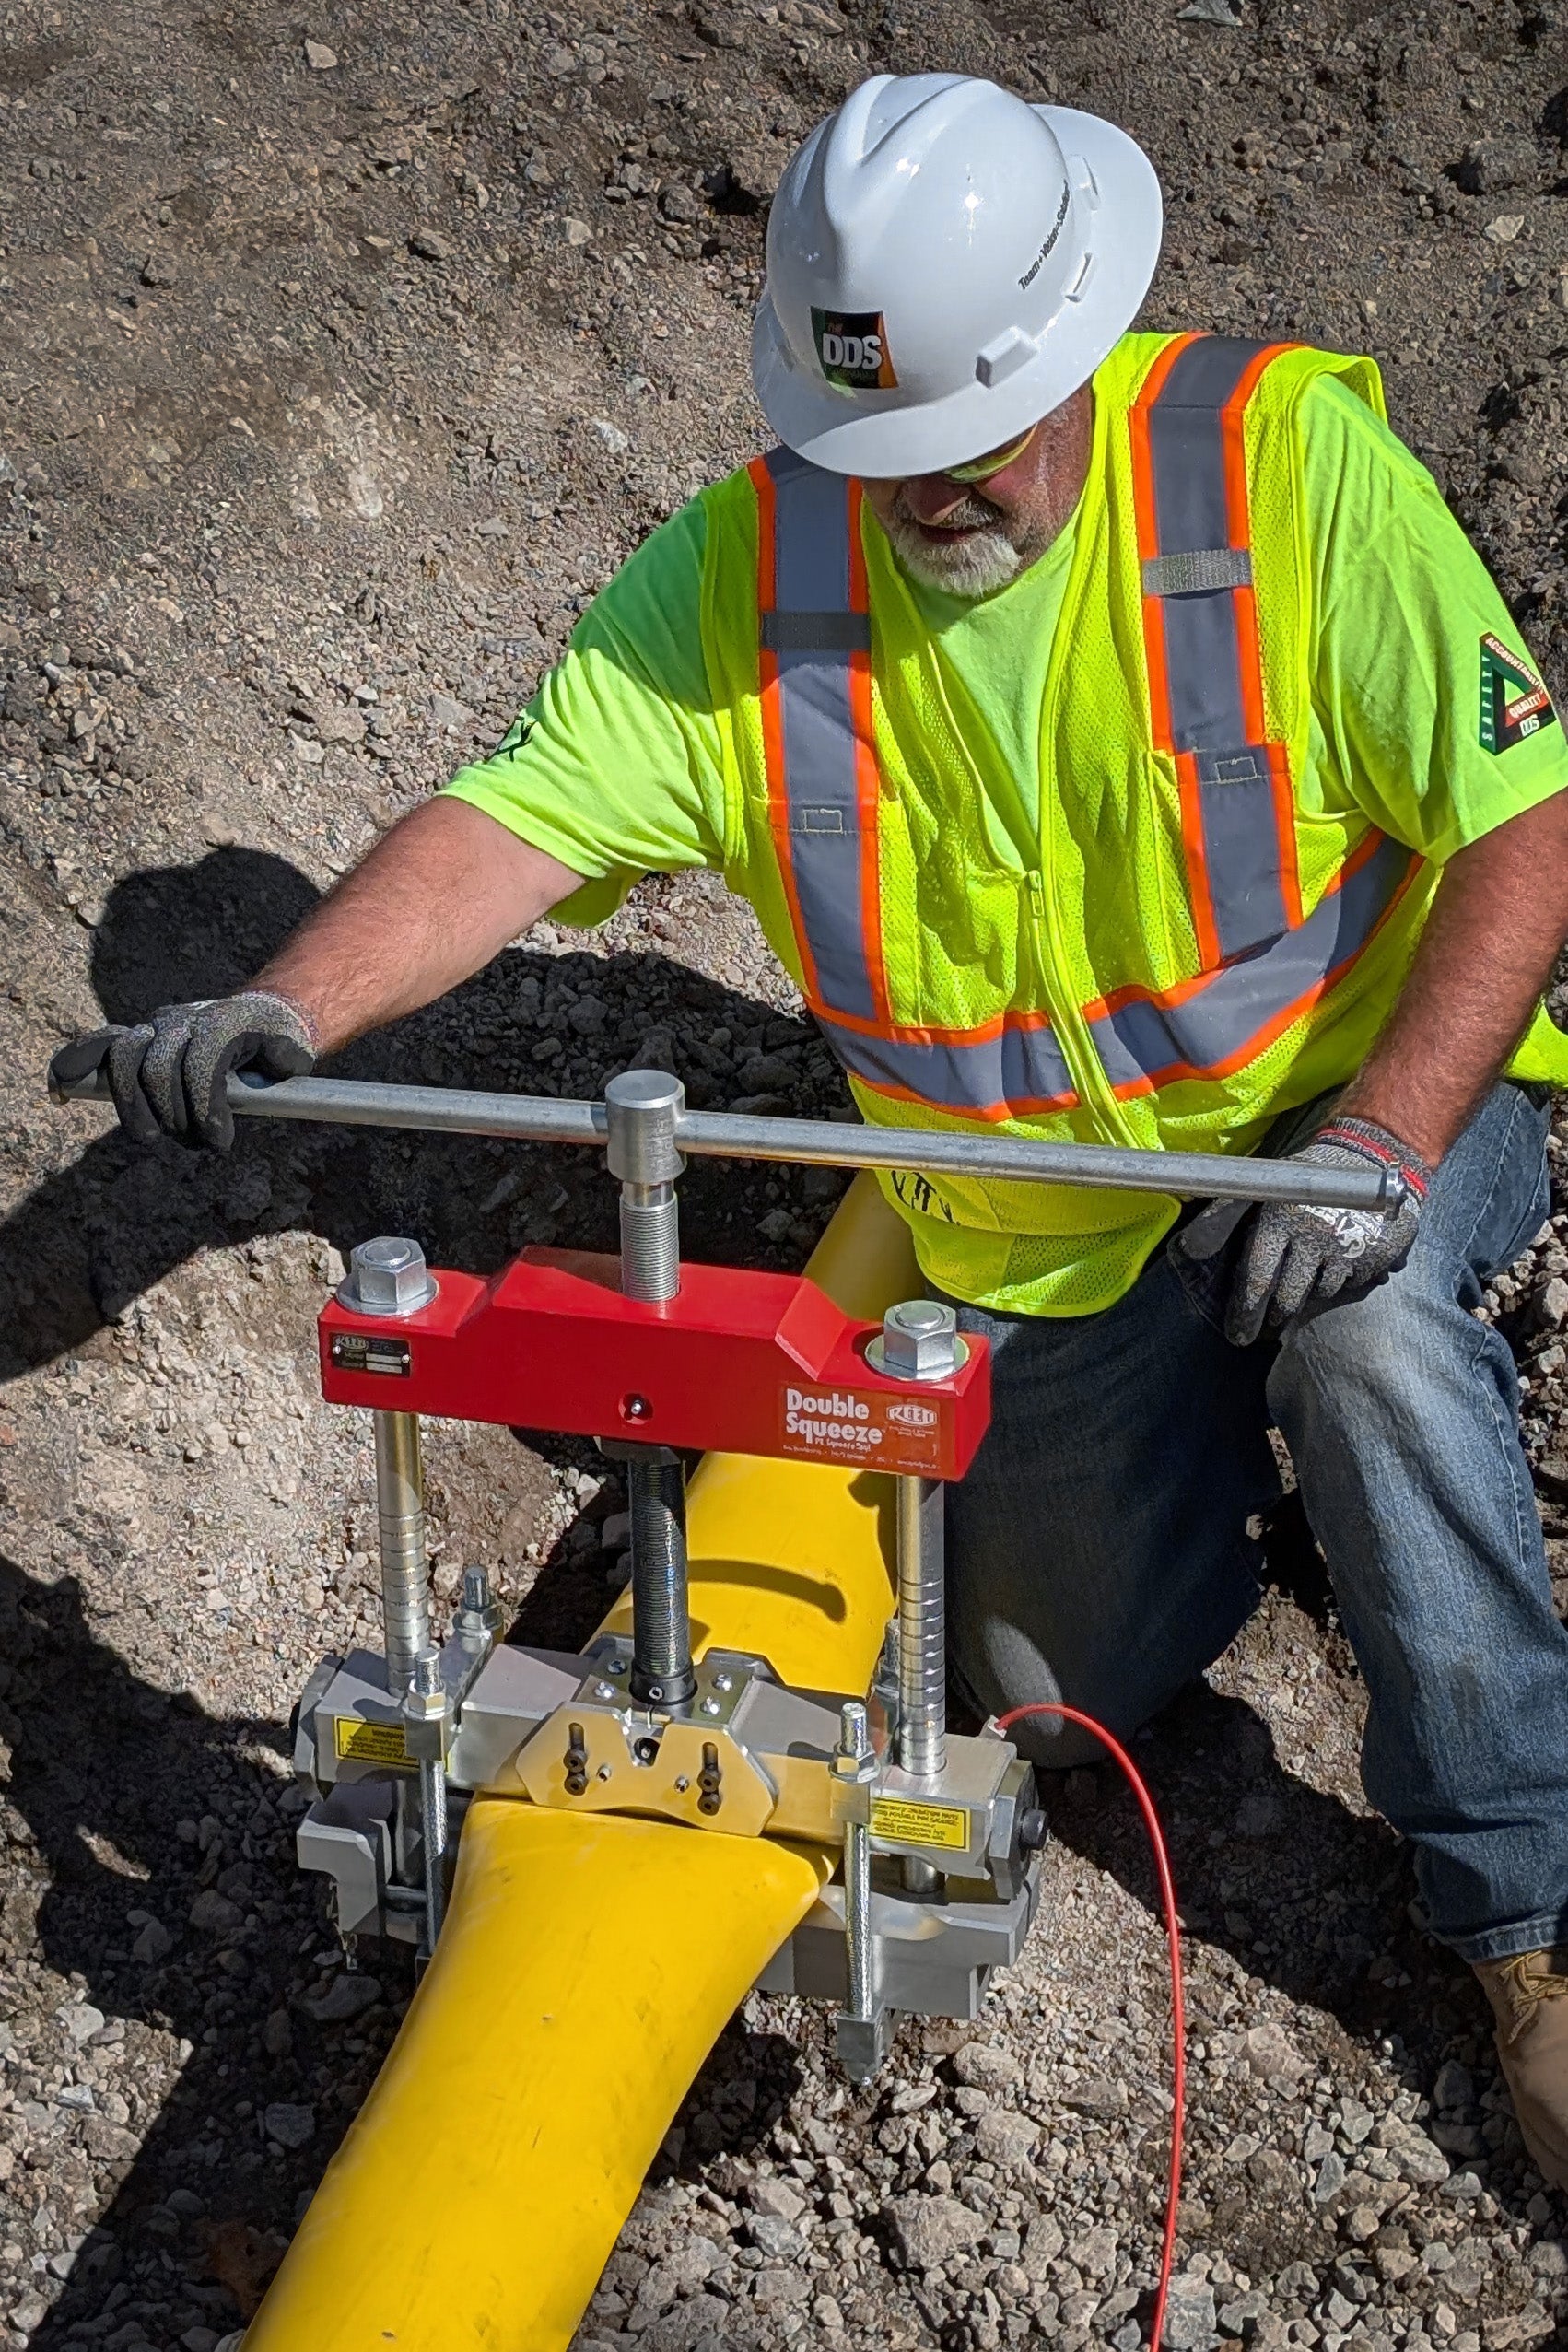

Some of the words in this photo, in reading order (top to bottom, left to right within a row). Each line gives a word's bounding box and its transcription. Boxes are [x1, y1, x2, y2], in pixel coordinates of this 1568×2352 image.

[823, 333, 883, 370] DDS
[787, 1388, 870, 1420] Double
[888, 1405, 936, 1425] REED
[786, 1411, 883, 1445] Squeeze
